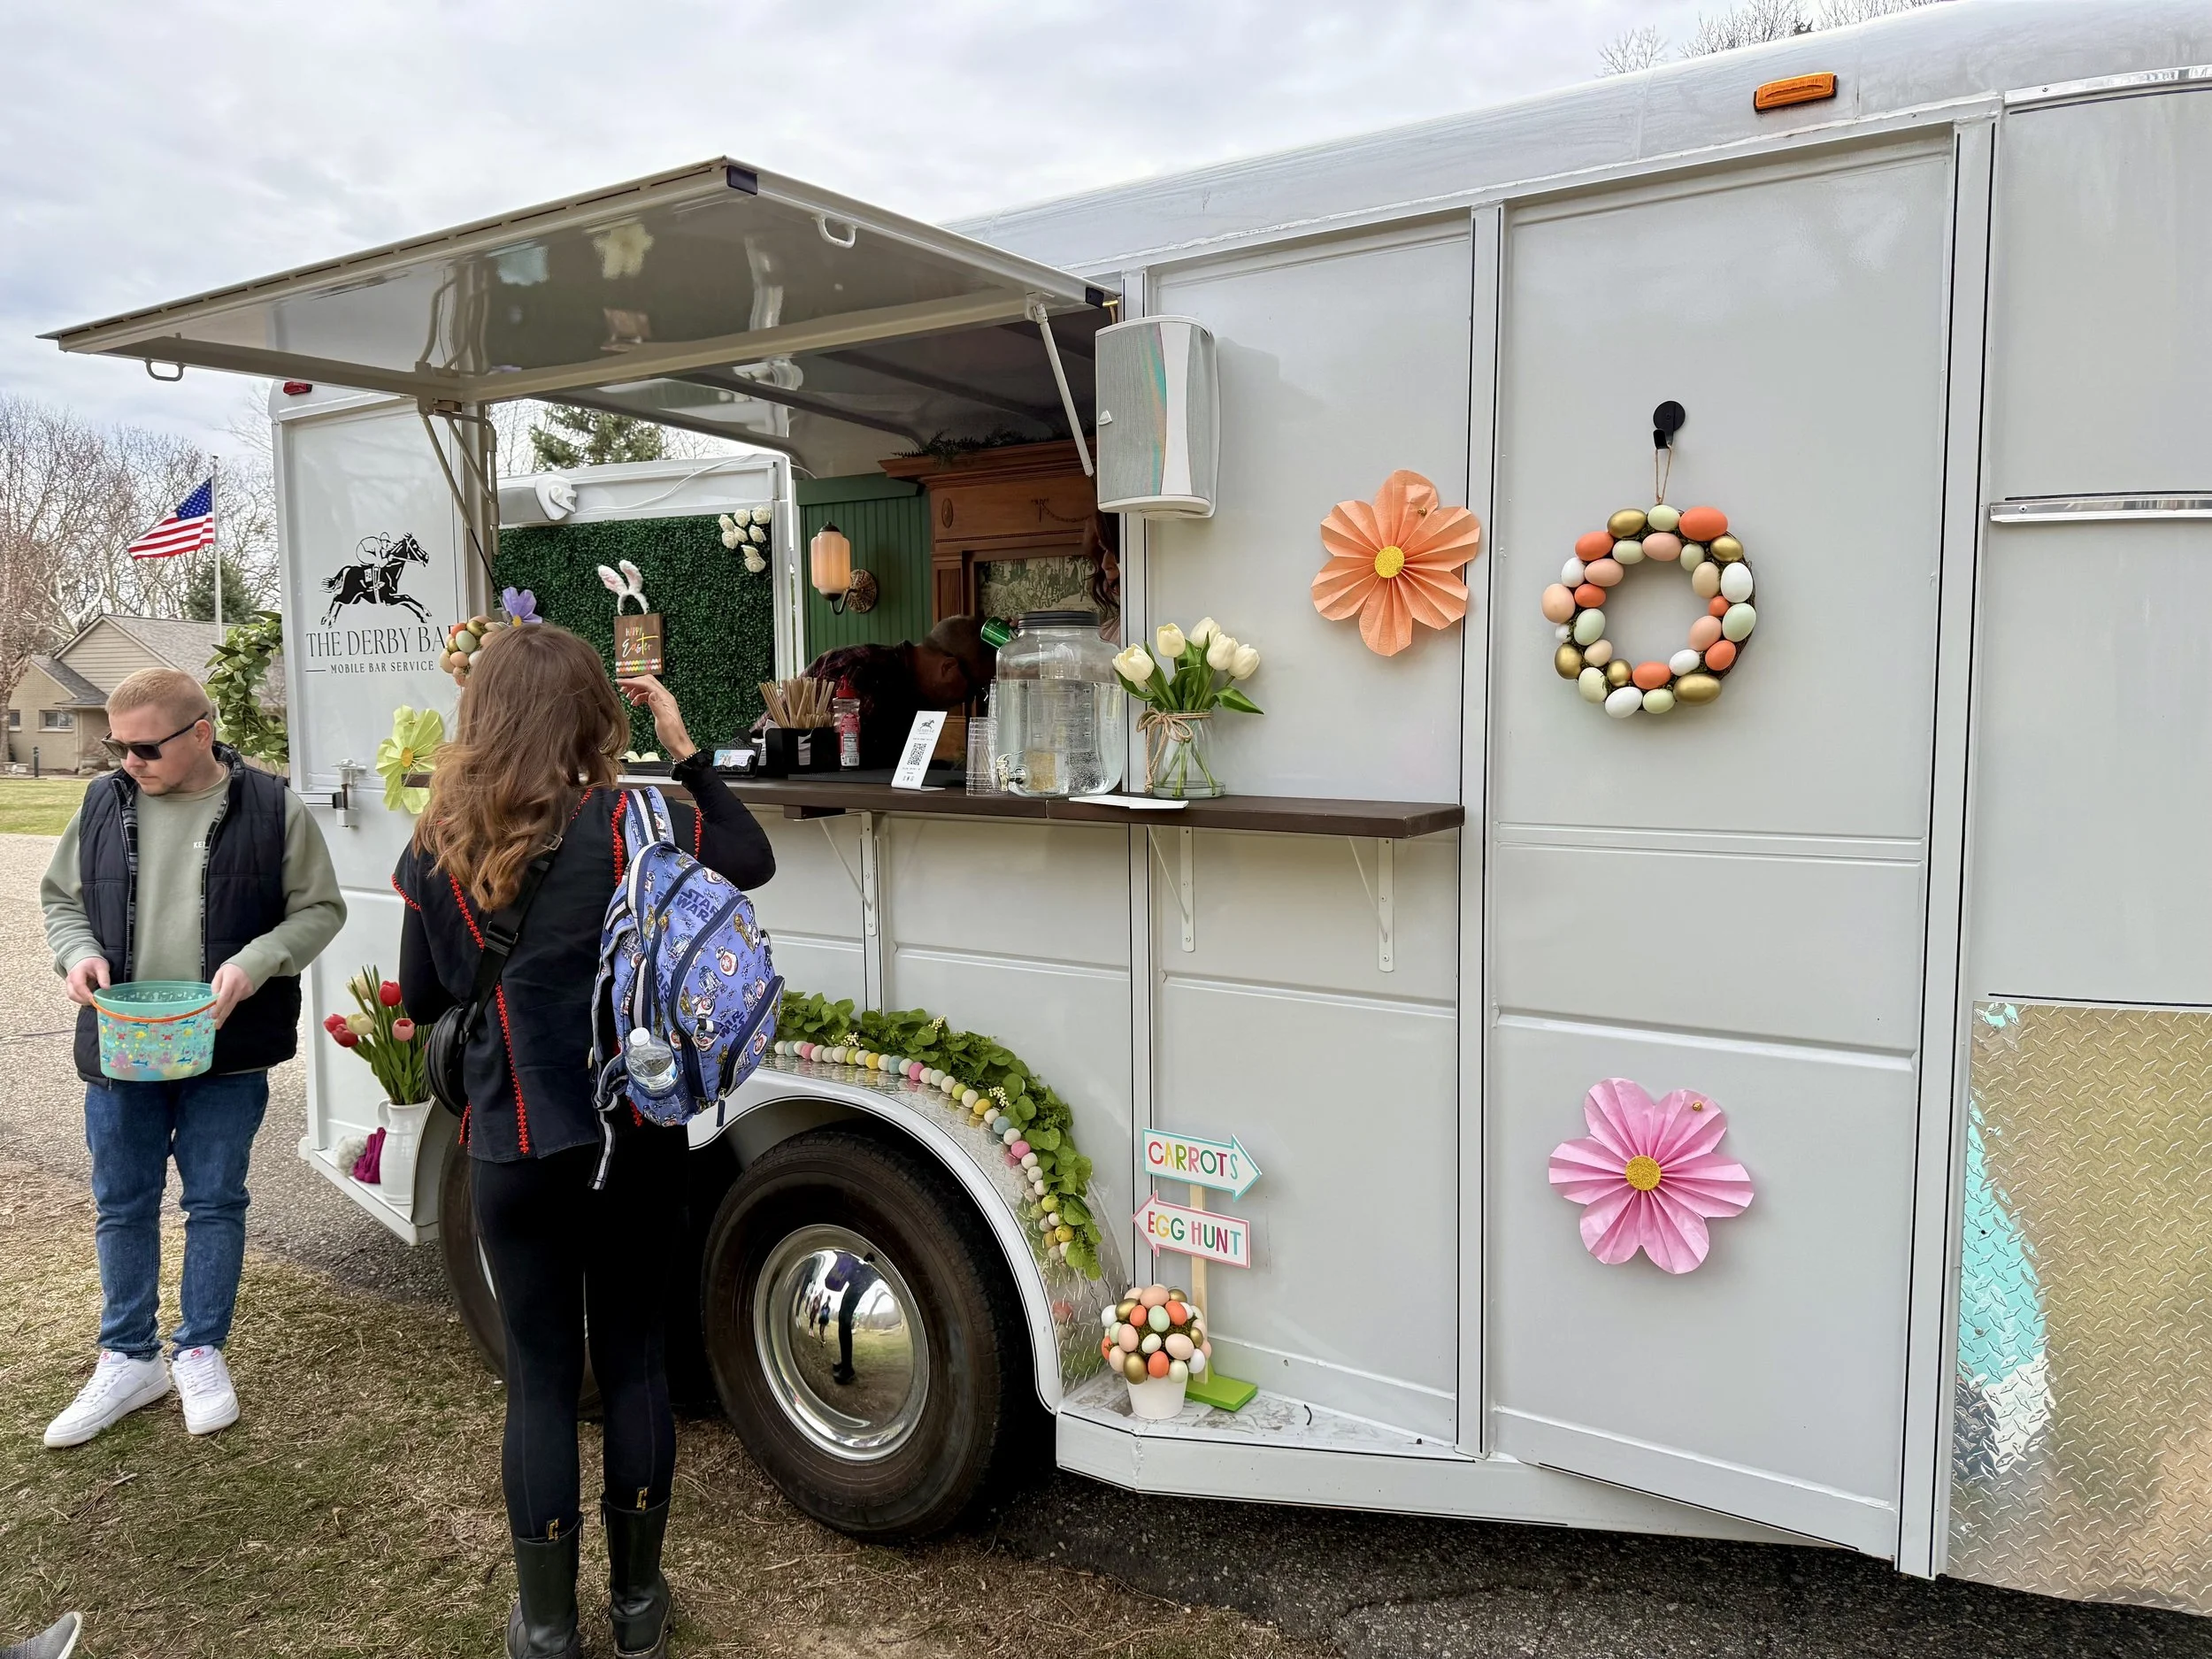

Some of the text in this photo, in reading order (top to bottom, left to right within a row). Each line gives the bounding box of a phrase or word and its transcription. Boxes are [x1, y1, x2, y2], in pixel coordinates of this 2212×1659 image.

[305, 632, 342, 657] THE
[347, 627, 411, 656] DERBY
[330, 660, 434, 674] MOBILE BAR SERVICE
[676, 895, 710, 924] WAR
[1148, 1141, 1239, 1180] CARROTS
[1148, 1210, 1241, 1256] EGG HUNT
